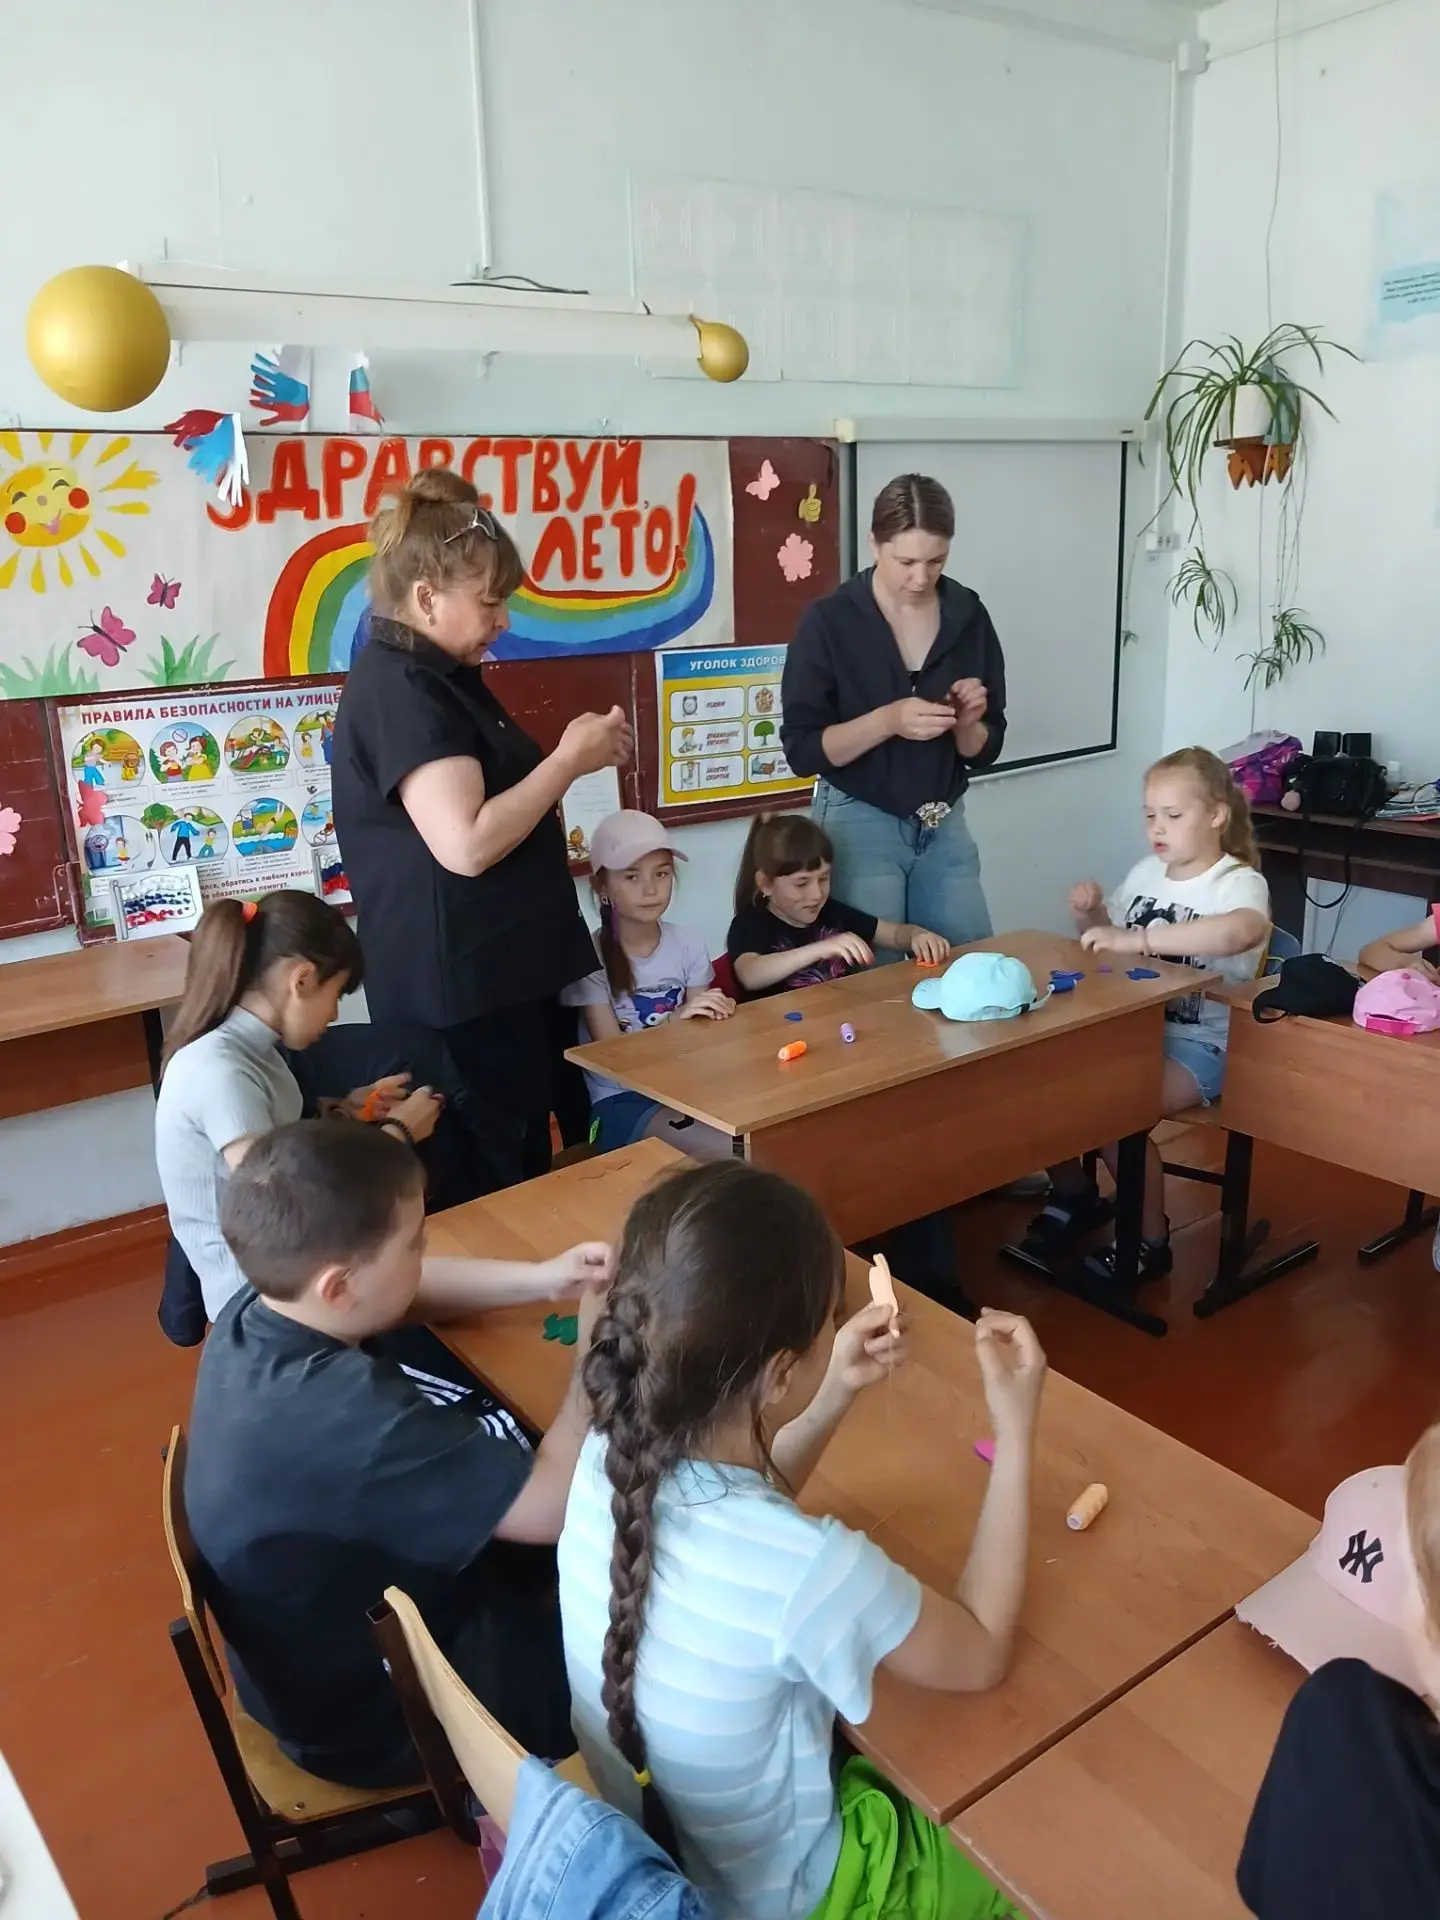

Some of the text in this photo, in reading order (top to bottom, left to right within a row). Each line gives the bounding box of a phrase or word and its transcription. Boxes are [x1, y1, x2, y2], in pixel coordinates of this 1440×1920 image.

[530, 472, 697, 583] ЛЕТО!
[689, 658, 738, 671] УГОЛОК
[81, 692, 341, 725] ПРАВИЛА БЕЗОПАСНОСТИ НА УЛИЦЕ
[212, 887, 258, 898] обязательно
[221, 878, 254, 889] обратись
[261, 873, 289, 882] любому
[1339, 1529, 1384, 1584] NY
